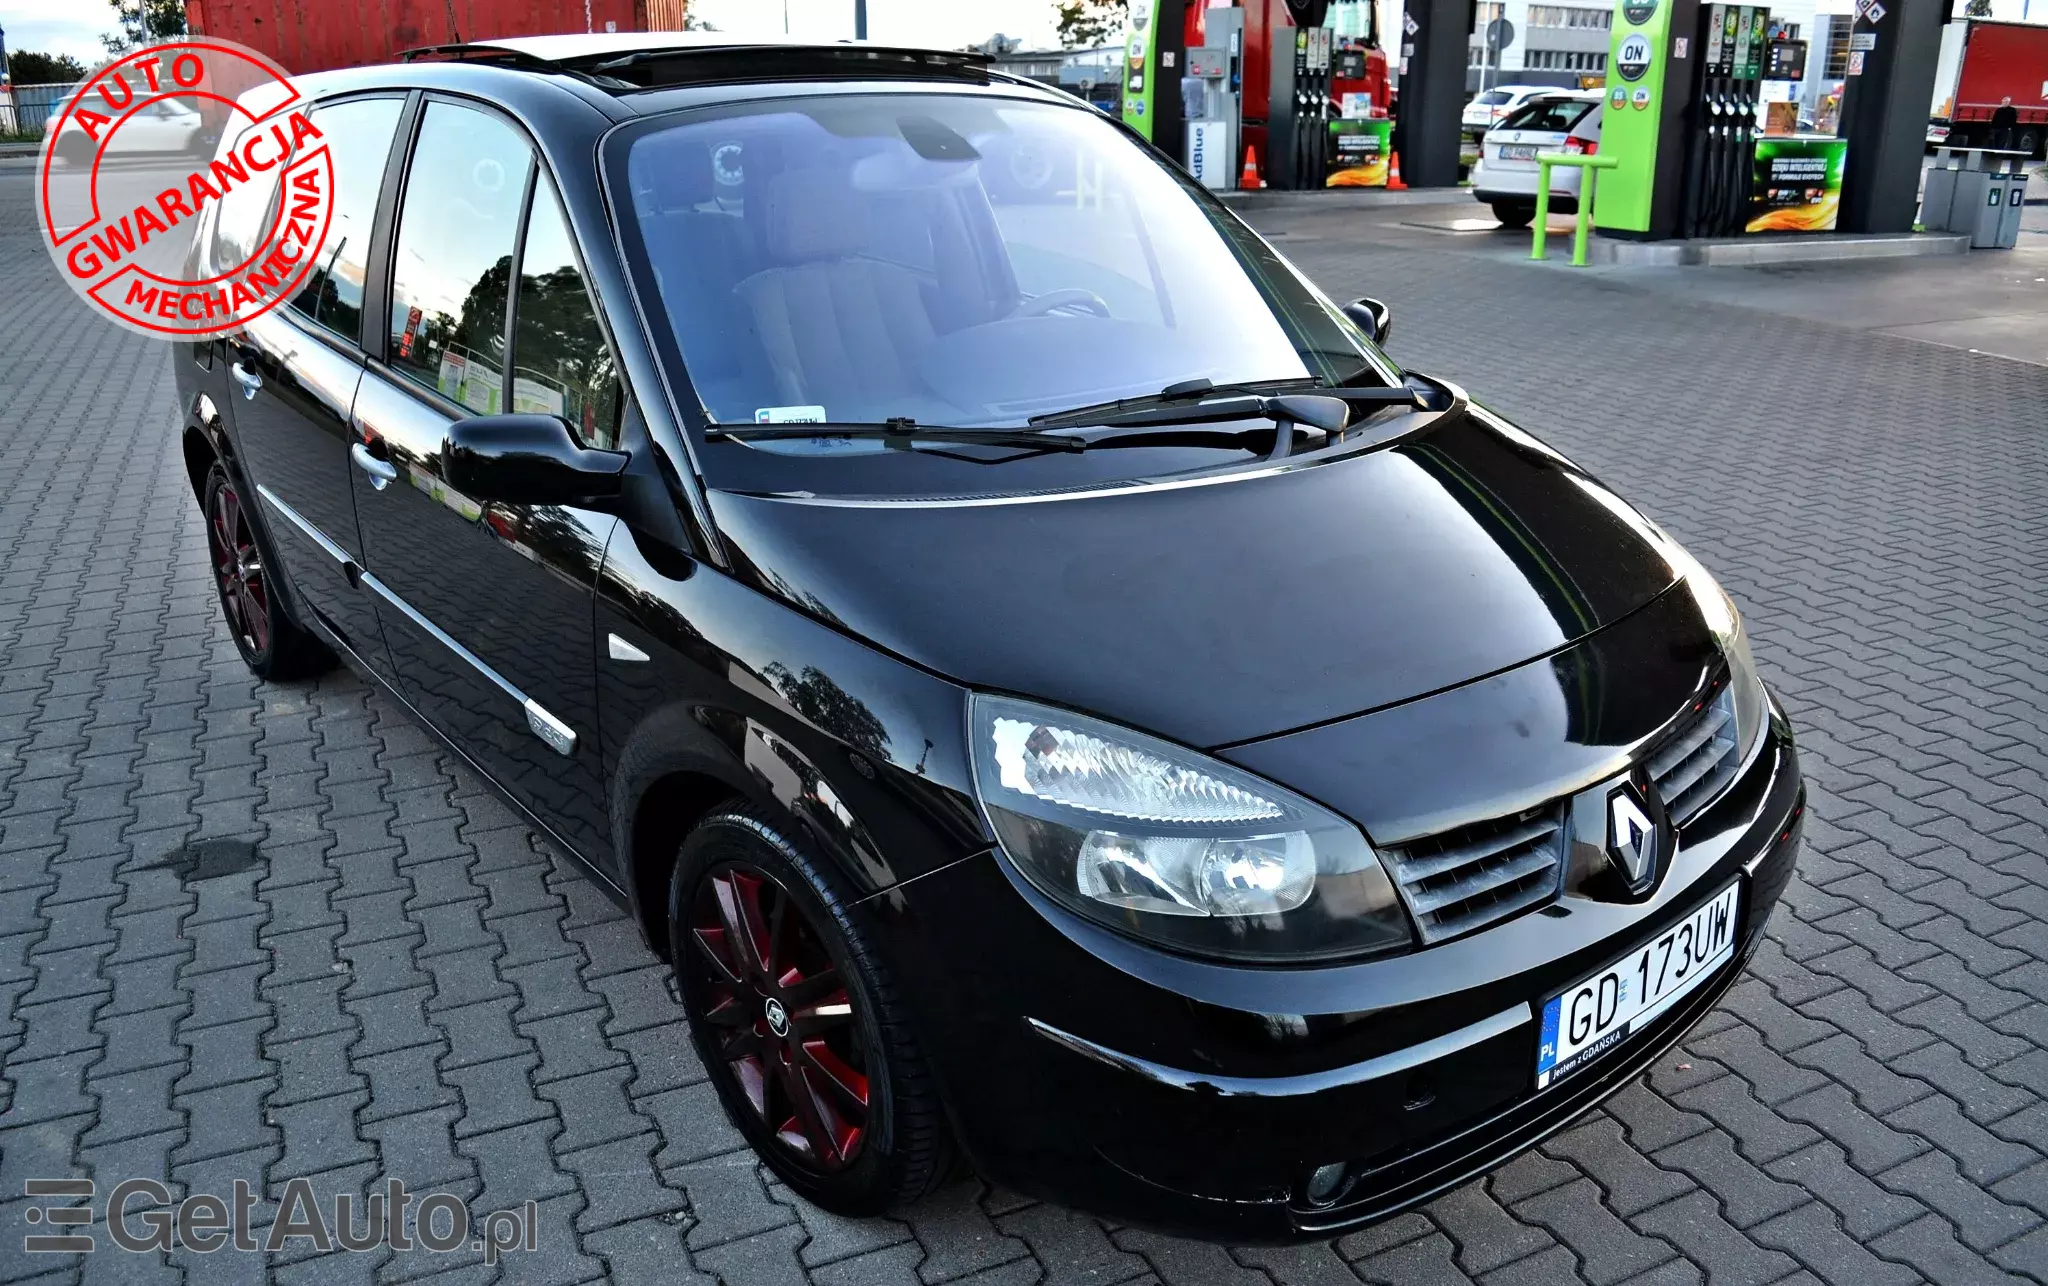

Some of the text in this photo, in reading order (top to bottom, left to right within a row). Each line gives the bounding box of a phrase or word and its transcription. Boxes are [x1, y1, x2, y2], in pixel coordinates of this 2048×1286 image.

[1625, 45, 1644, 61] ON
[1636, 92, 1646, 100] ON
[1193, 128, 1204, 183] AdBlue
[1569, 891, 1732, 1046] GD 173UW
[1540, 1043, 1555, 1062] PL
[1552, 1059, 1577, 1081] jestem
[1582, 1030, 1622, 1061] GDAŃSKA
